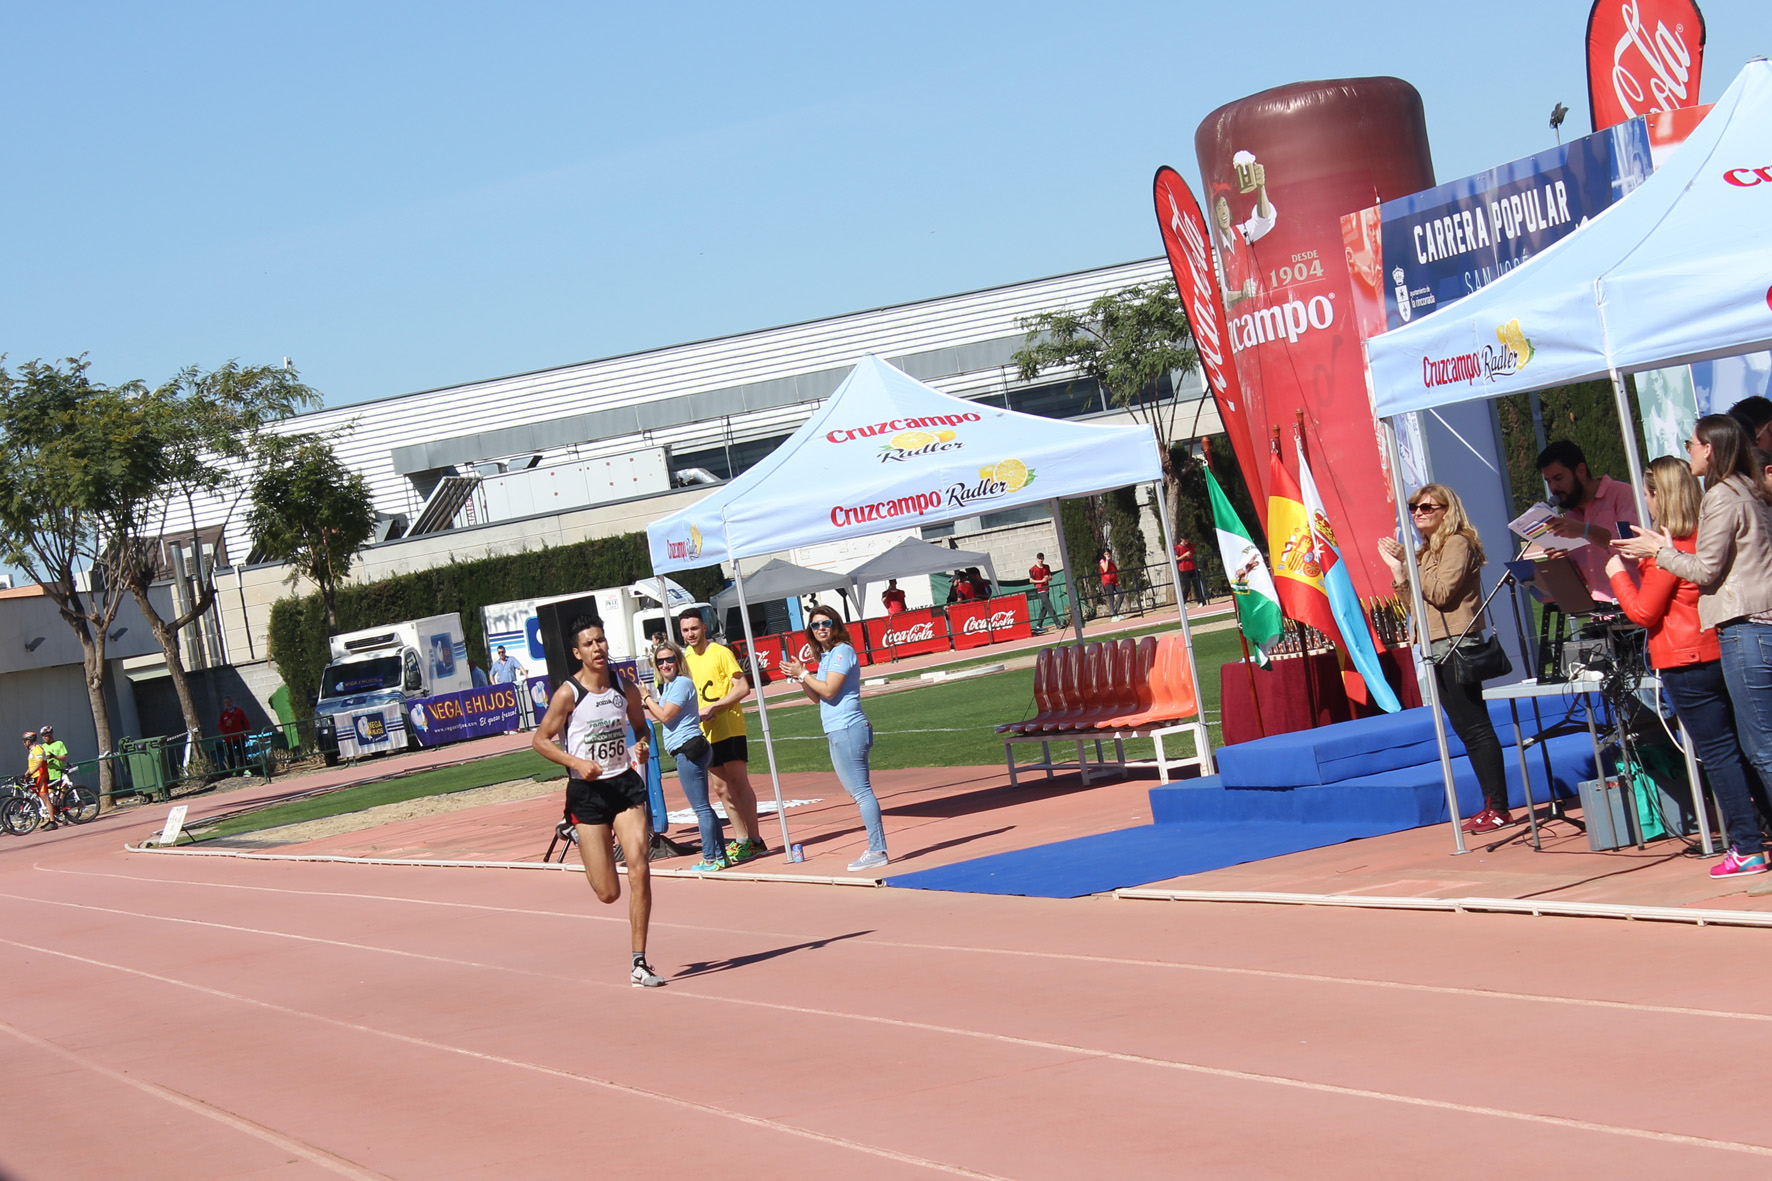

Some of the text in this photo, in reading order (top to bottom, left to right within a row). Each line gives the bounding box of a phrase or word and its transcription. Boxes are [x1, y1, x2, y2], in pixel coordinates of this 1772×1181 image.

[1414, 181, 1571, 264] CARRERA POPULAR
[1291, 250, 1319, 262] DESDE
[1270, 259, 1324, 287] 1904
[1423, 345, 1518, 388] Cruzcampo Radler
[826, 412, 981, 444] Cruzcampo
[877, 441, 965, 464] Radler
[831, 478, 1007, 527] Cruzcampo Radler
[428, 690, 515, 720] VEGA E HIJOS
[588, 739, 625, 761] 1656
